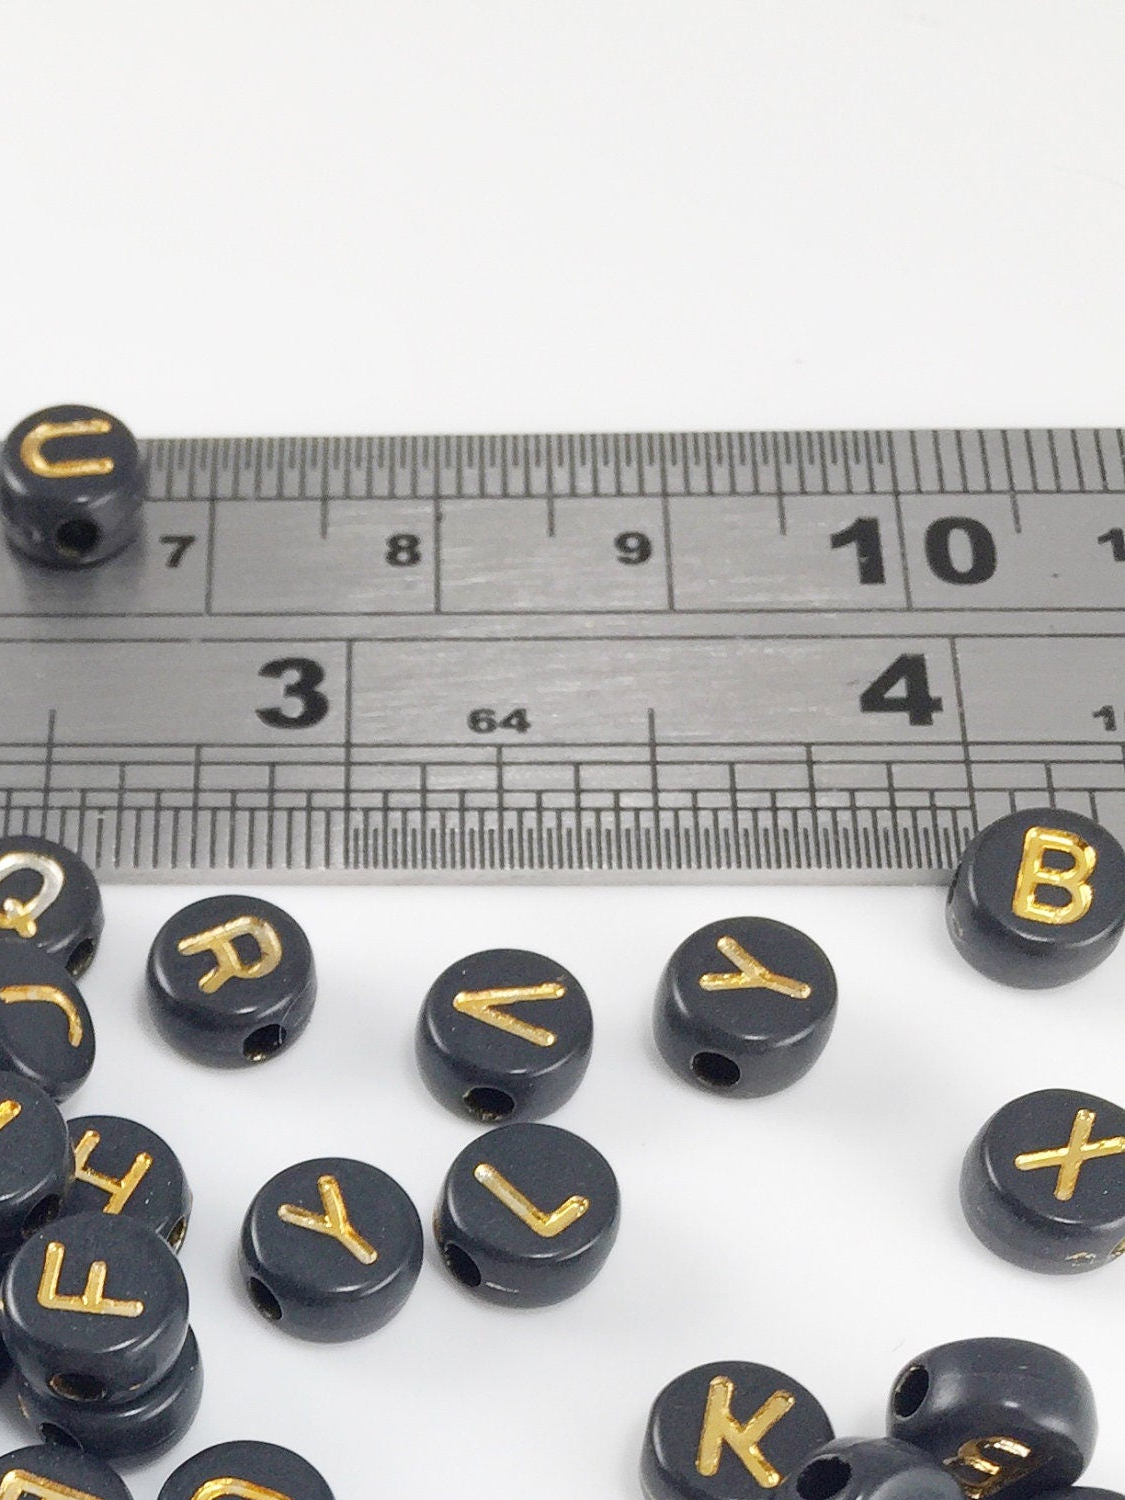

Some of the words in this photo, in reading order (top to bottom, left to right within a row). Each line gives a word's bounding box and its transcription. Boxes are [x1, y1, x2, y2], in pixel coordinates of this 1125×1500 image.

[21, 416, 113, 477] U
[161, 535, 197, 568] 7
[384, 533, 422, 567] 8
[614, 531, 653, 565] 9
[255, 658, 330, 728] 3
[467, 708, 531, 734] 64
[860, 653, 943, 726] 4
[1013, 827, 1097, 924] B
[179, 916, 281, 992] R
[700, 937, 811, 998] Y
[455, 982, 565, 1046] V
[1015, 1109, 1125, 1199] X
[280, 1175, 377, 1263] Y
[474, 1164, 589, 1236] L
[38, 1242, 143, 1315] F
[697, 1377, 793, 1487] K
